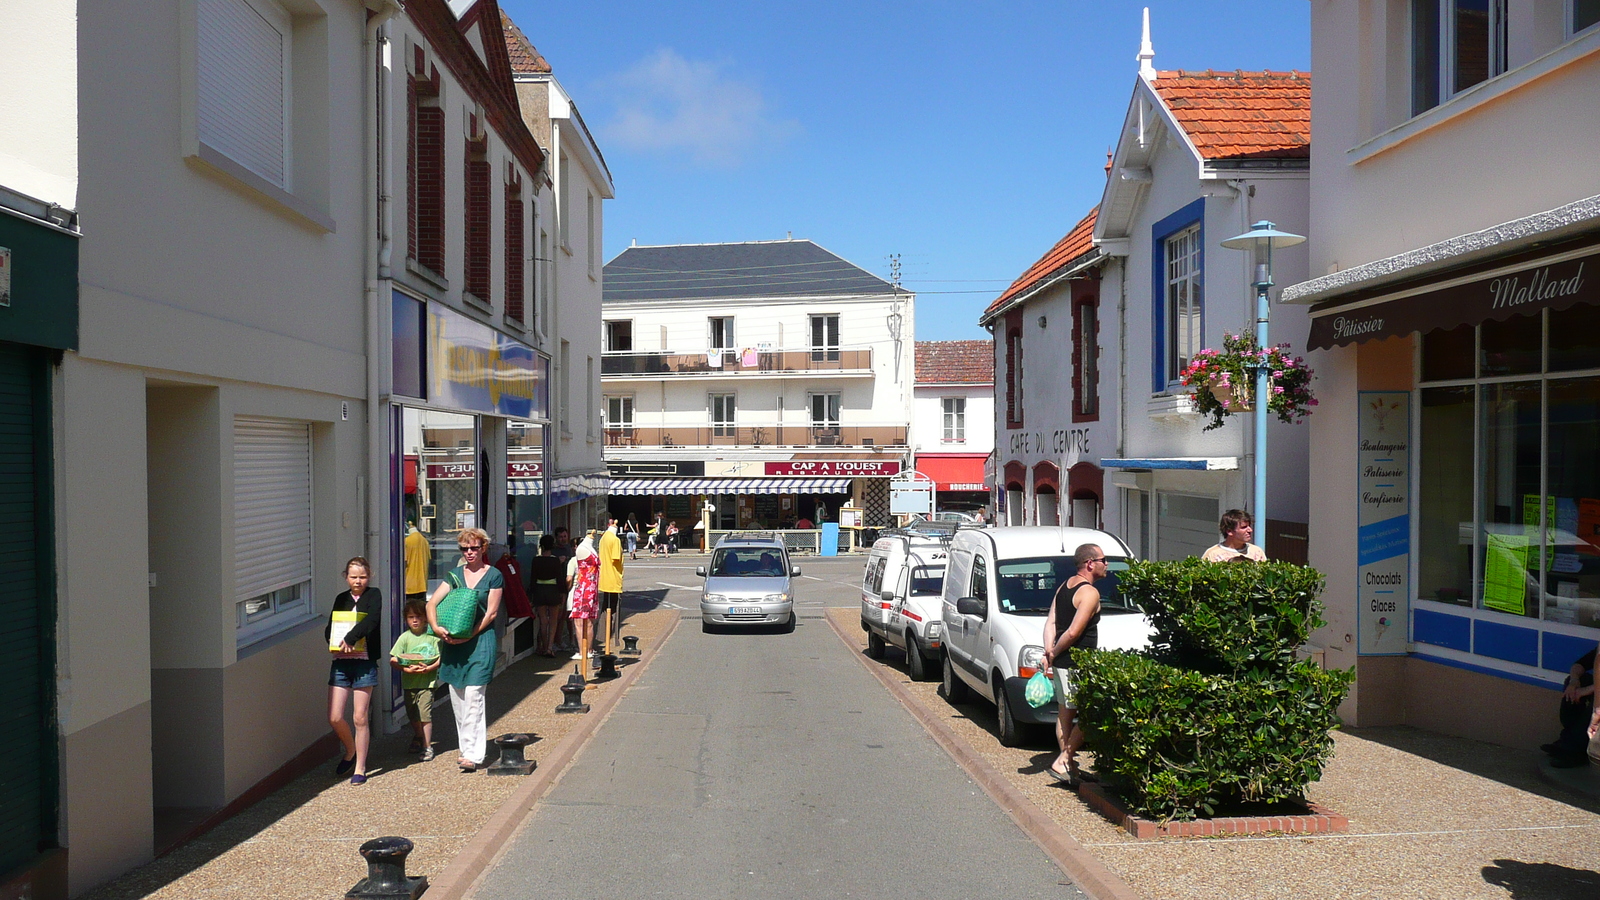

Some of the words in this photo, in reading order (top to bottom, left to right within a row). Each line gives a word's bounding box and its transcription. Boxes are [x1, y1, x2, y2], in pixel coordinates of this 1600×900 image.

[1333, 316, 1384, 339] Pâtissier
[1489, 261, 1585, 310] Mallard
[1010, 432, 1030, 454] CAFE
[1035, 431, 1046, 454] DU
[1052, 427, 1090, 454] CENTRE
[1360, 439, 1408, 456] Boulangerie
[791, 461, 816, 471] CAP
[820, 461, 830, 471] A
[835, 461, 884, 471] L'OUEST
[949, 483, 984, 491] BOUCHERIE
[1362, 491, 1405, 509] Confiserie
[1365, 571, 1402, 585] Chocolats
[1370, 598, 1397, 613] Glaces
